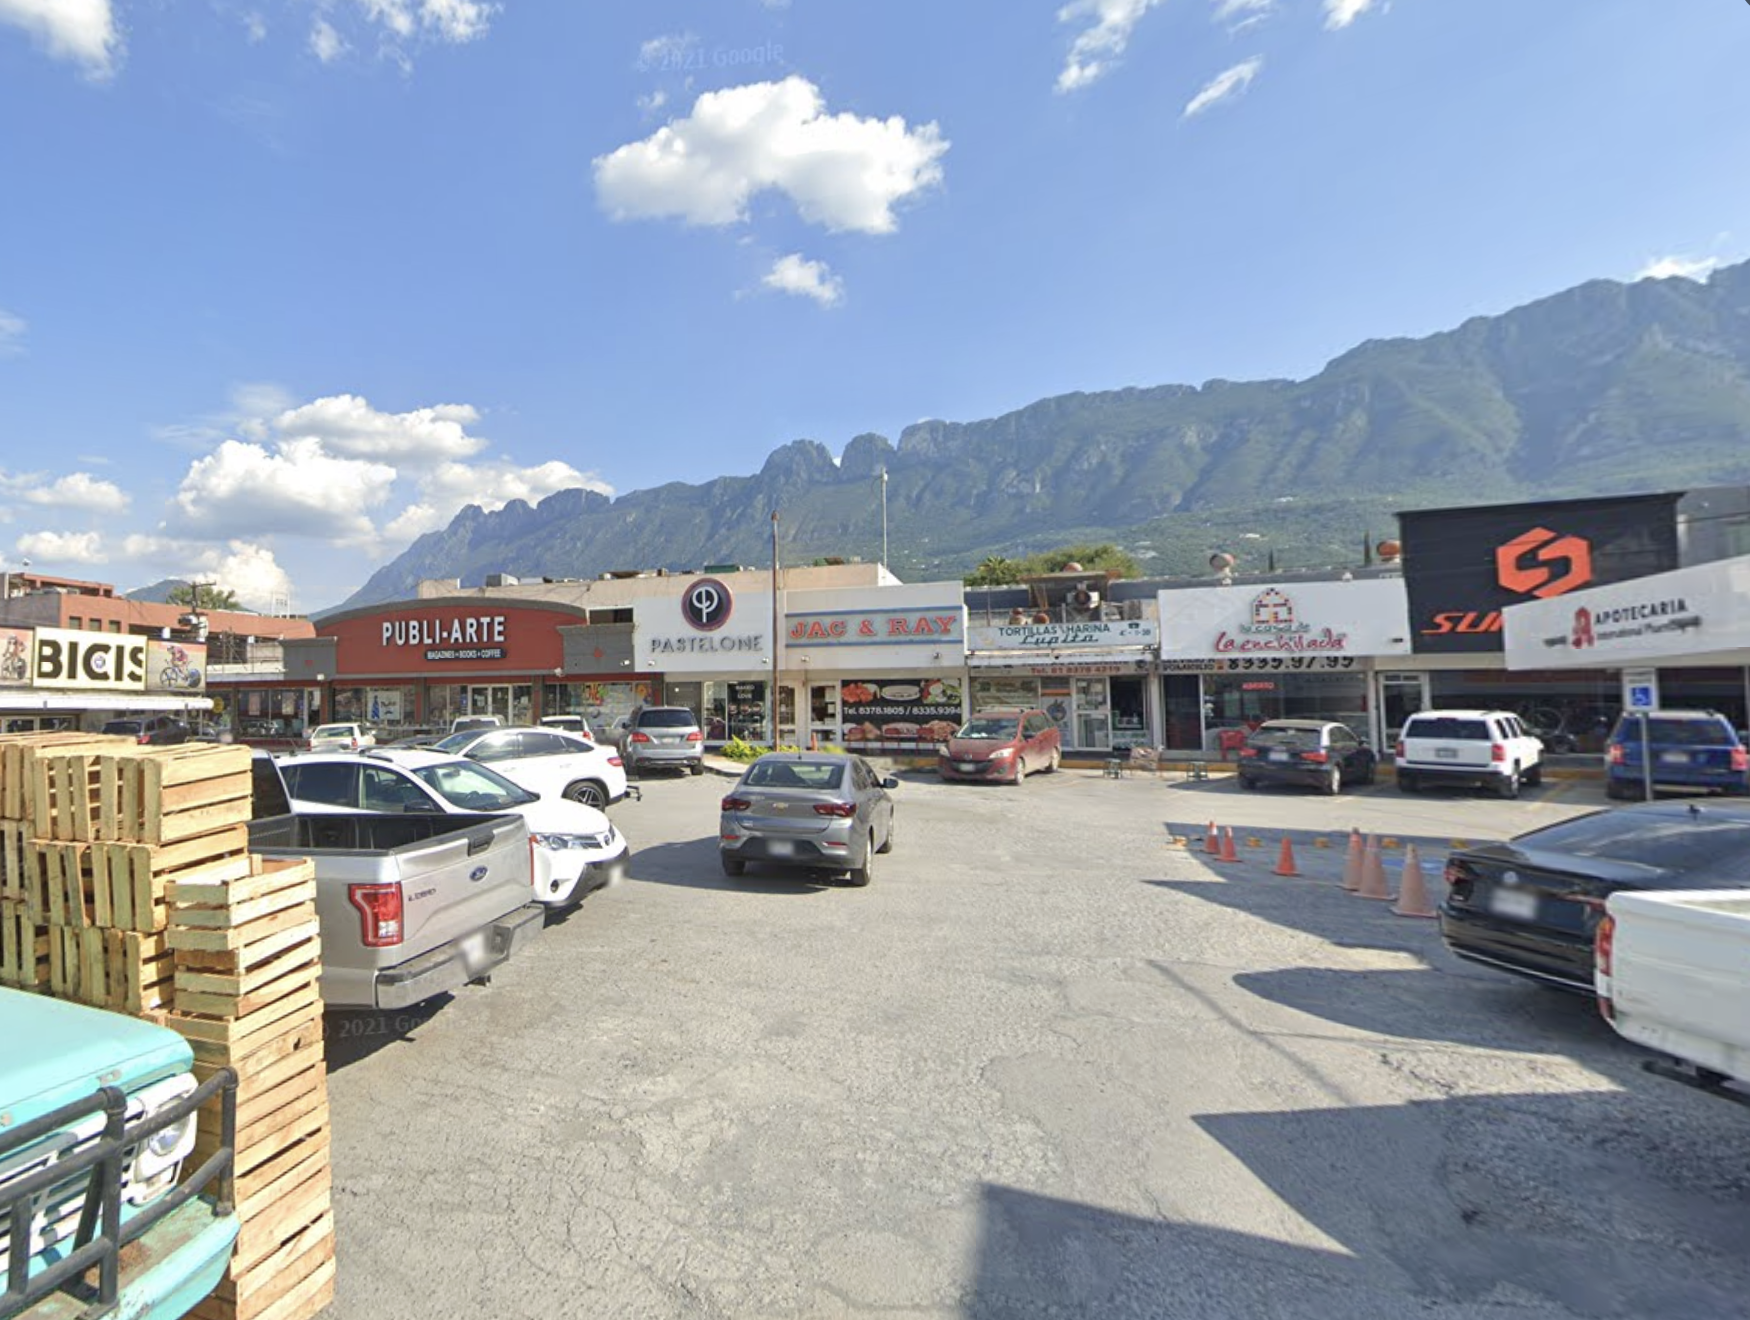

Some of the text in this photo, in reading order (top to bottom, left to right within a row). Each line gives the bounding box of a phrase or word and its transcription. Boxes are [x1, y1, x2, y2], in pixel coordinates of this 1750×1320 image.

[1595, 598, 1688, 624] APOTECARIA
[382, 616, 505, 646] PUBLI-ARTE
[789, 615, 956, 640] JAC & RAY
[999, 626, 1058, 637] TORTILLAS
[1065, 623, 1110, 634] HARINA
[651, 635, 763, 653] PASTELONE
[1240, 628, 1348, 652] enchilada
[37, 638, 144, 682] BICIS
[427, 649, 501, 659] MAGAZINES BOOKS COFFEE
[843, 707, 857, 715] Tel.
